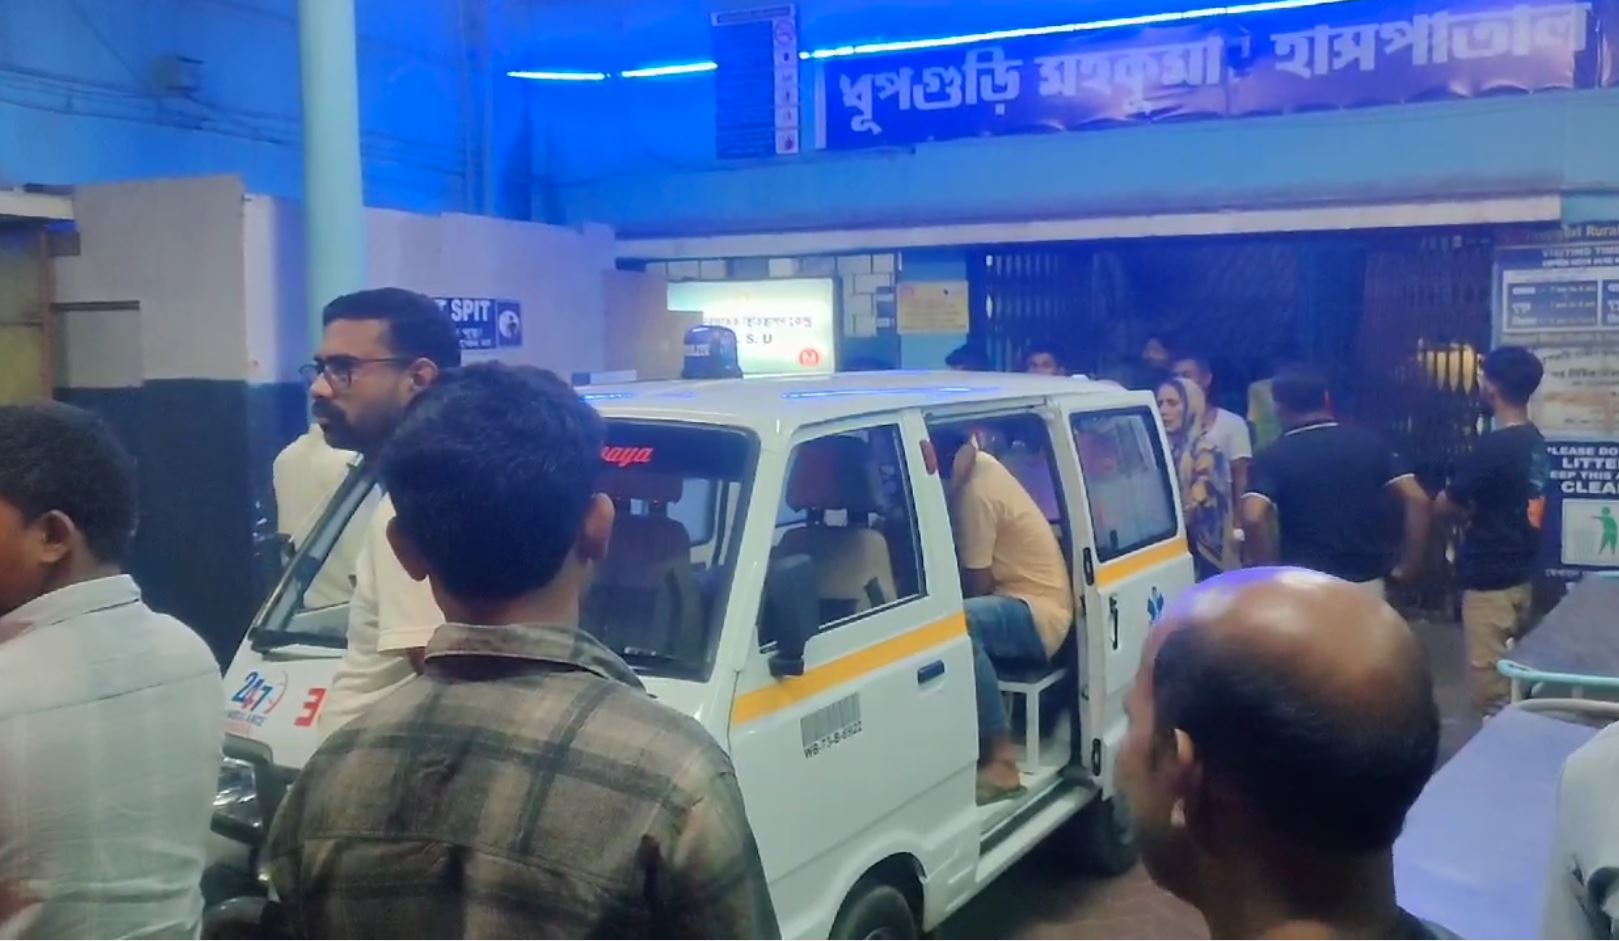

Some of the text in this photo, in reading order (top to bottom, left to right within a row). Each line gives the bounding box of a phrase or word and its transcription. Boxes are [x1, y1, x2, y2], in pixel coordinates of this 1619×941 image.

[1269, 2, 1592, 79] হাসপাতাল
[451, 299, 491, 322] SPIT
[1599, 446, 1619, 456] DO
[1562, 457, 1619, 469] LITTE
[1580, 471, 1611, 480] THIS
[1561, 481, 1619, 495] CLEA
